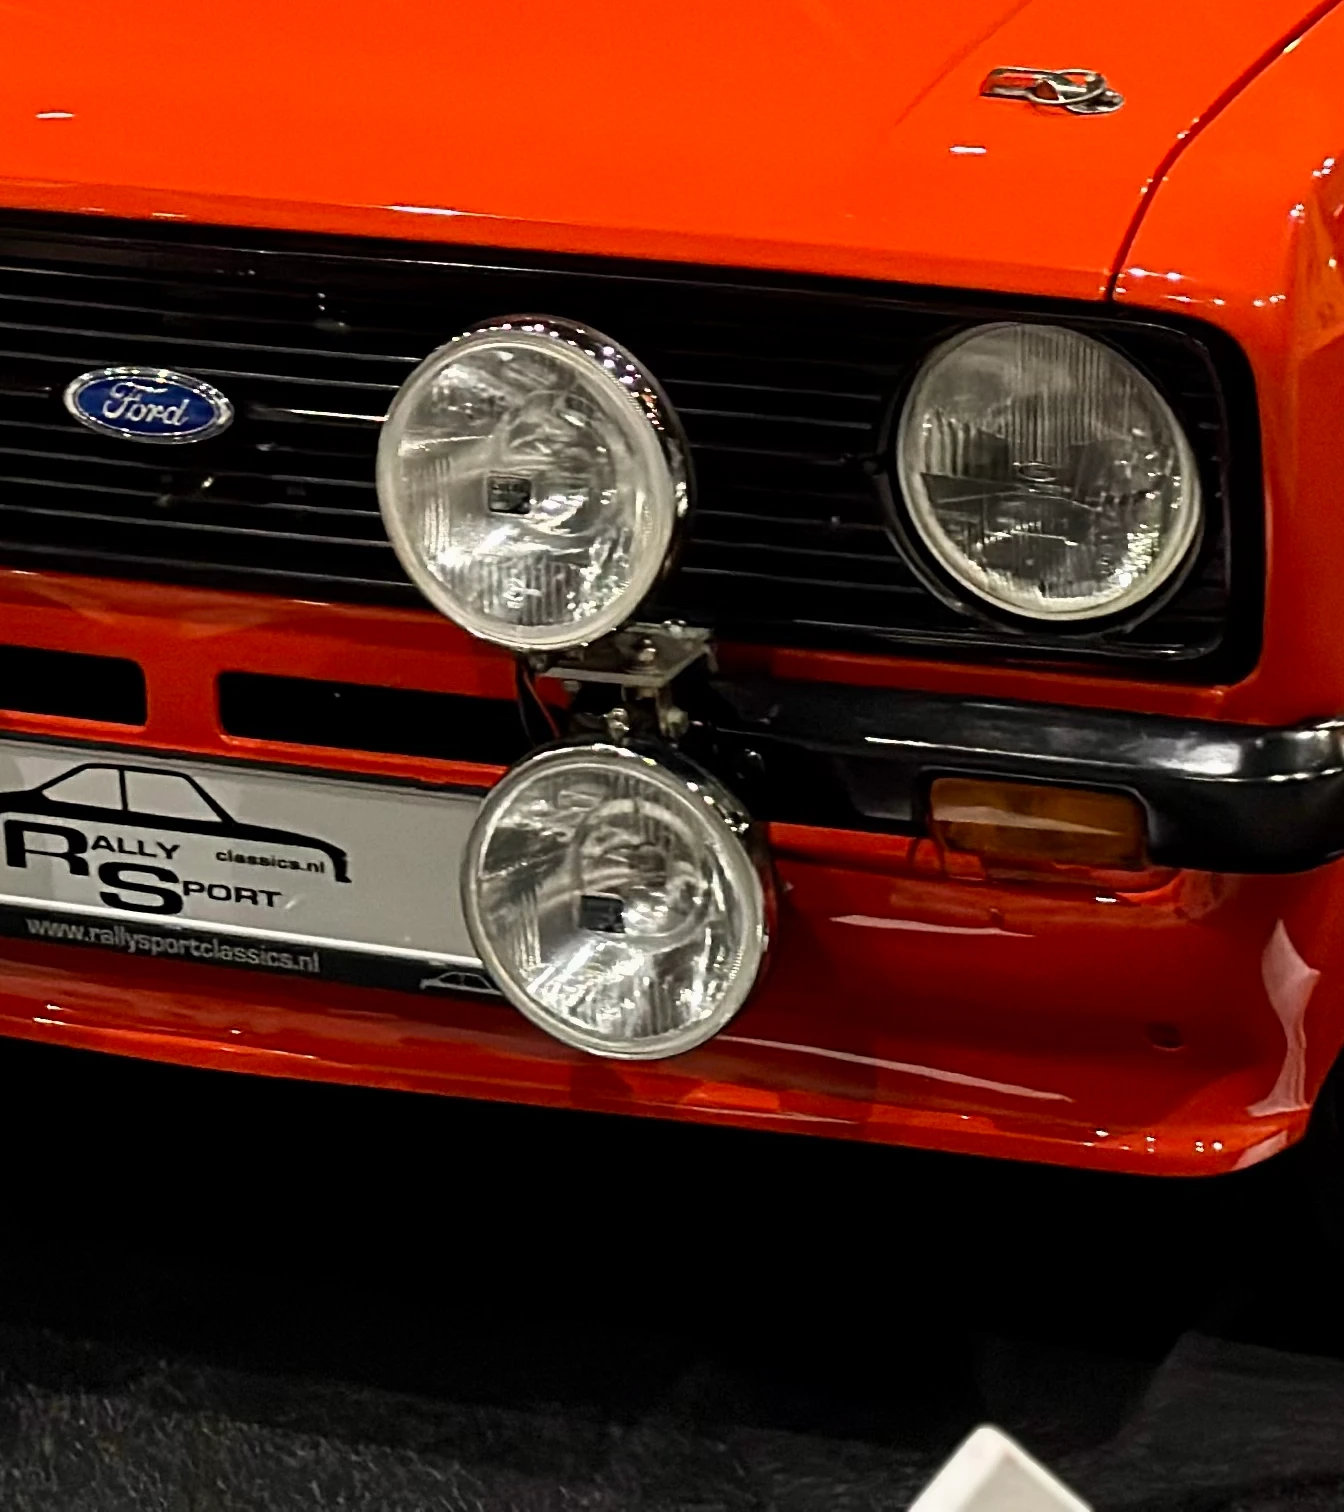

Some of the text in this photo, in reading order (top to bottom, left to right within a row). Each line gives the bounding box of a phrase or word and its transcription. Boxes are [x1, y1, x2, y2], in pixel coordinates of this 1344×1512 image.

[102, 381, 190, 427] Ford
[4, 819, 325, 877] RALLY classics.nl
[98, 861, 282, 915] SPORT
[25, 917, 321, 974] www.rallysportclassics.nl
